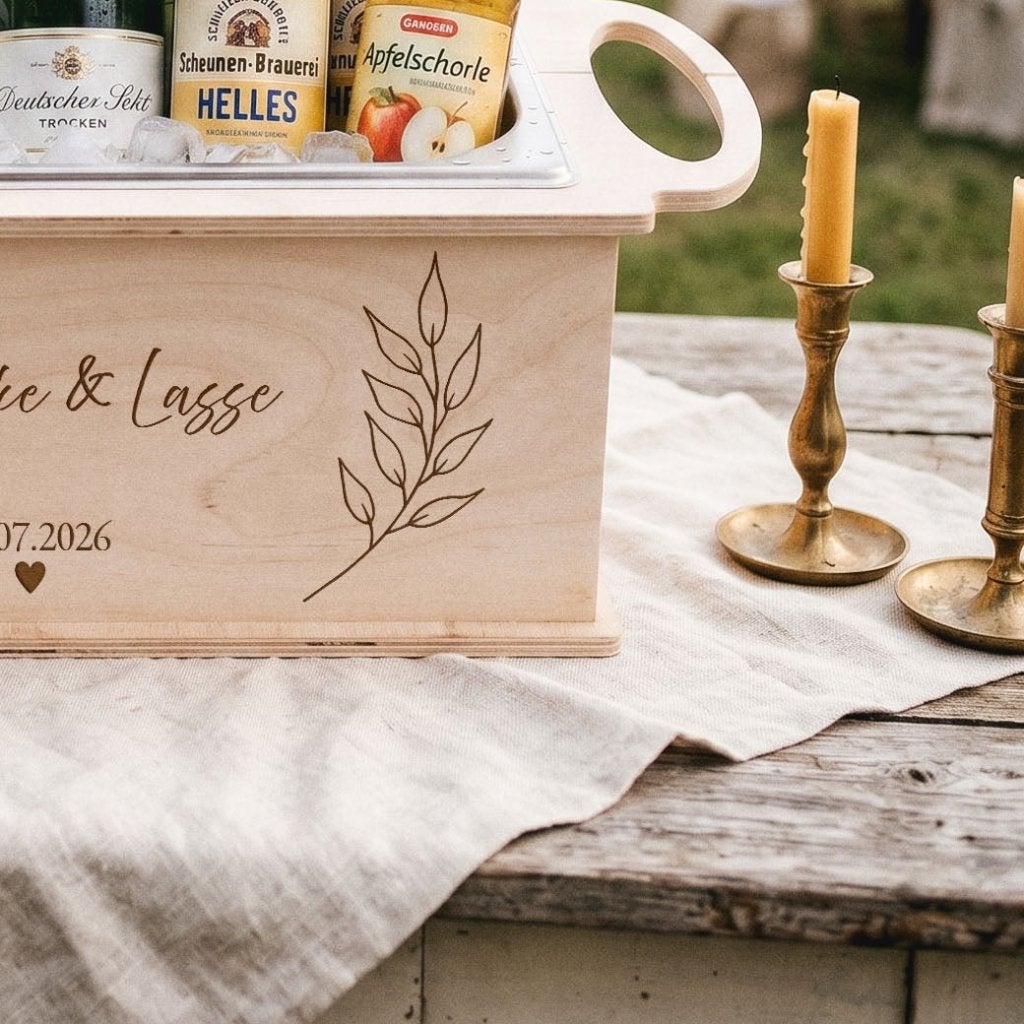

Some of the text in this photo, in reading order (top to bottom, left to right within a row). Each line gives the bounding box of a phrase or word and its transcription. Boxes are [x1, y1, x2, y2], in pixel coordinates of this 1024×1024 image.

[362, 42, 491, 82] Apfelschorle
[104, 83, 152, 112] Sekt
[198, 87, 298, 123] HELLES
[39, 118, 107, 128] TROCKEN
[66, 355, 114, 412] &
[131, 347, 283, 435] Lasse
